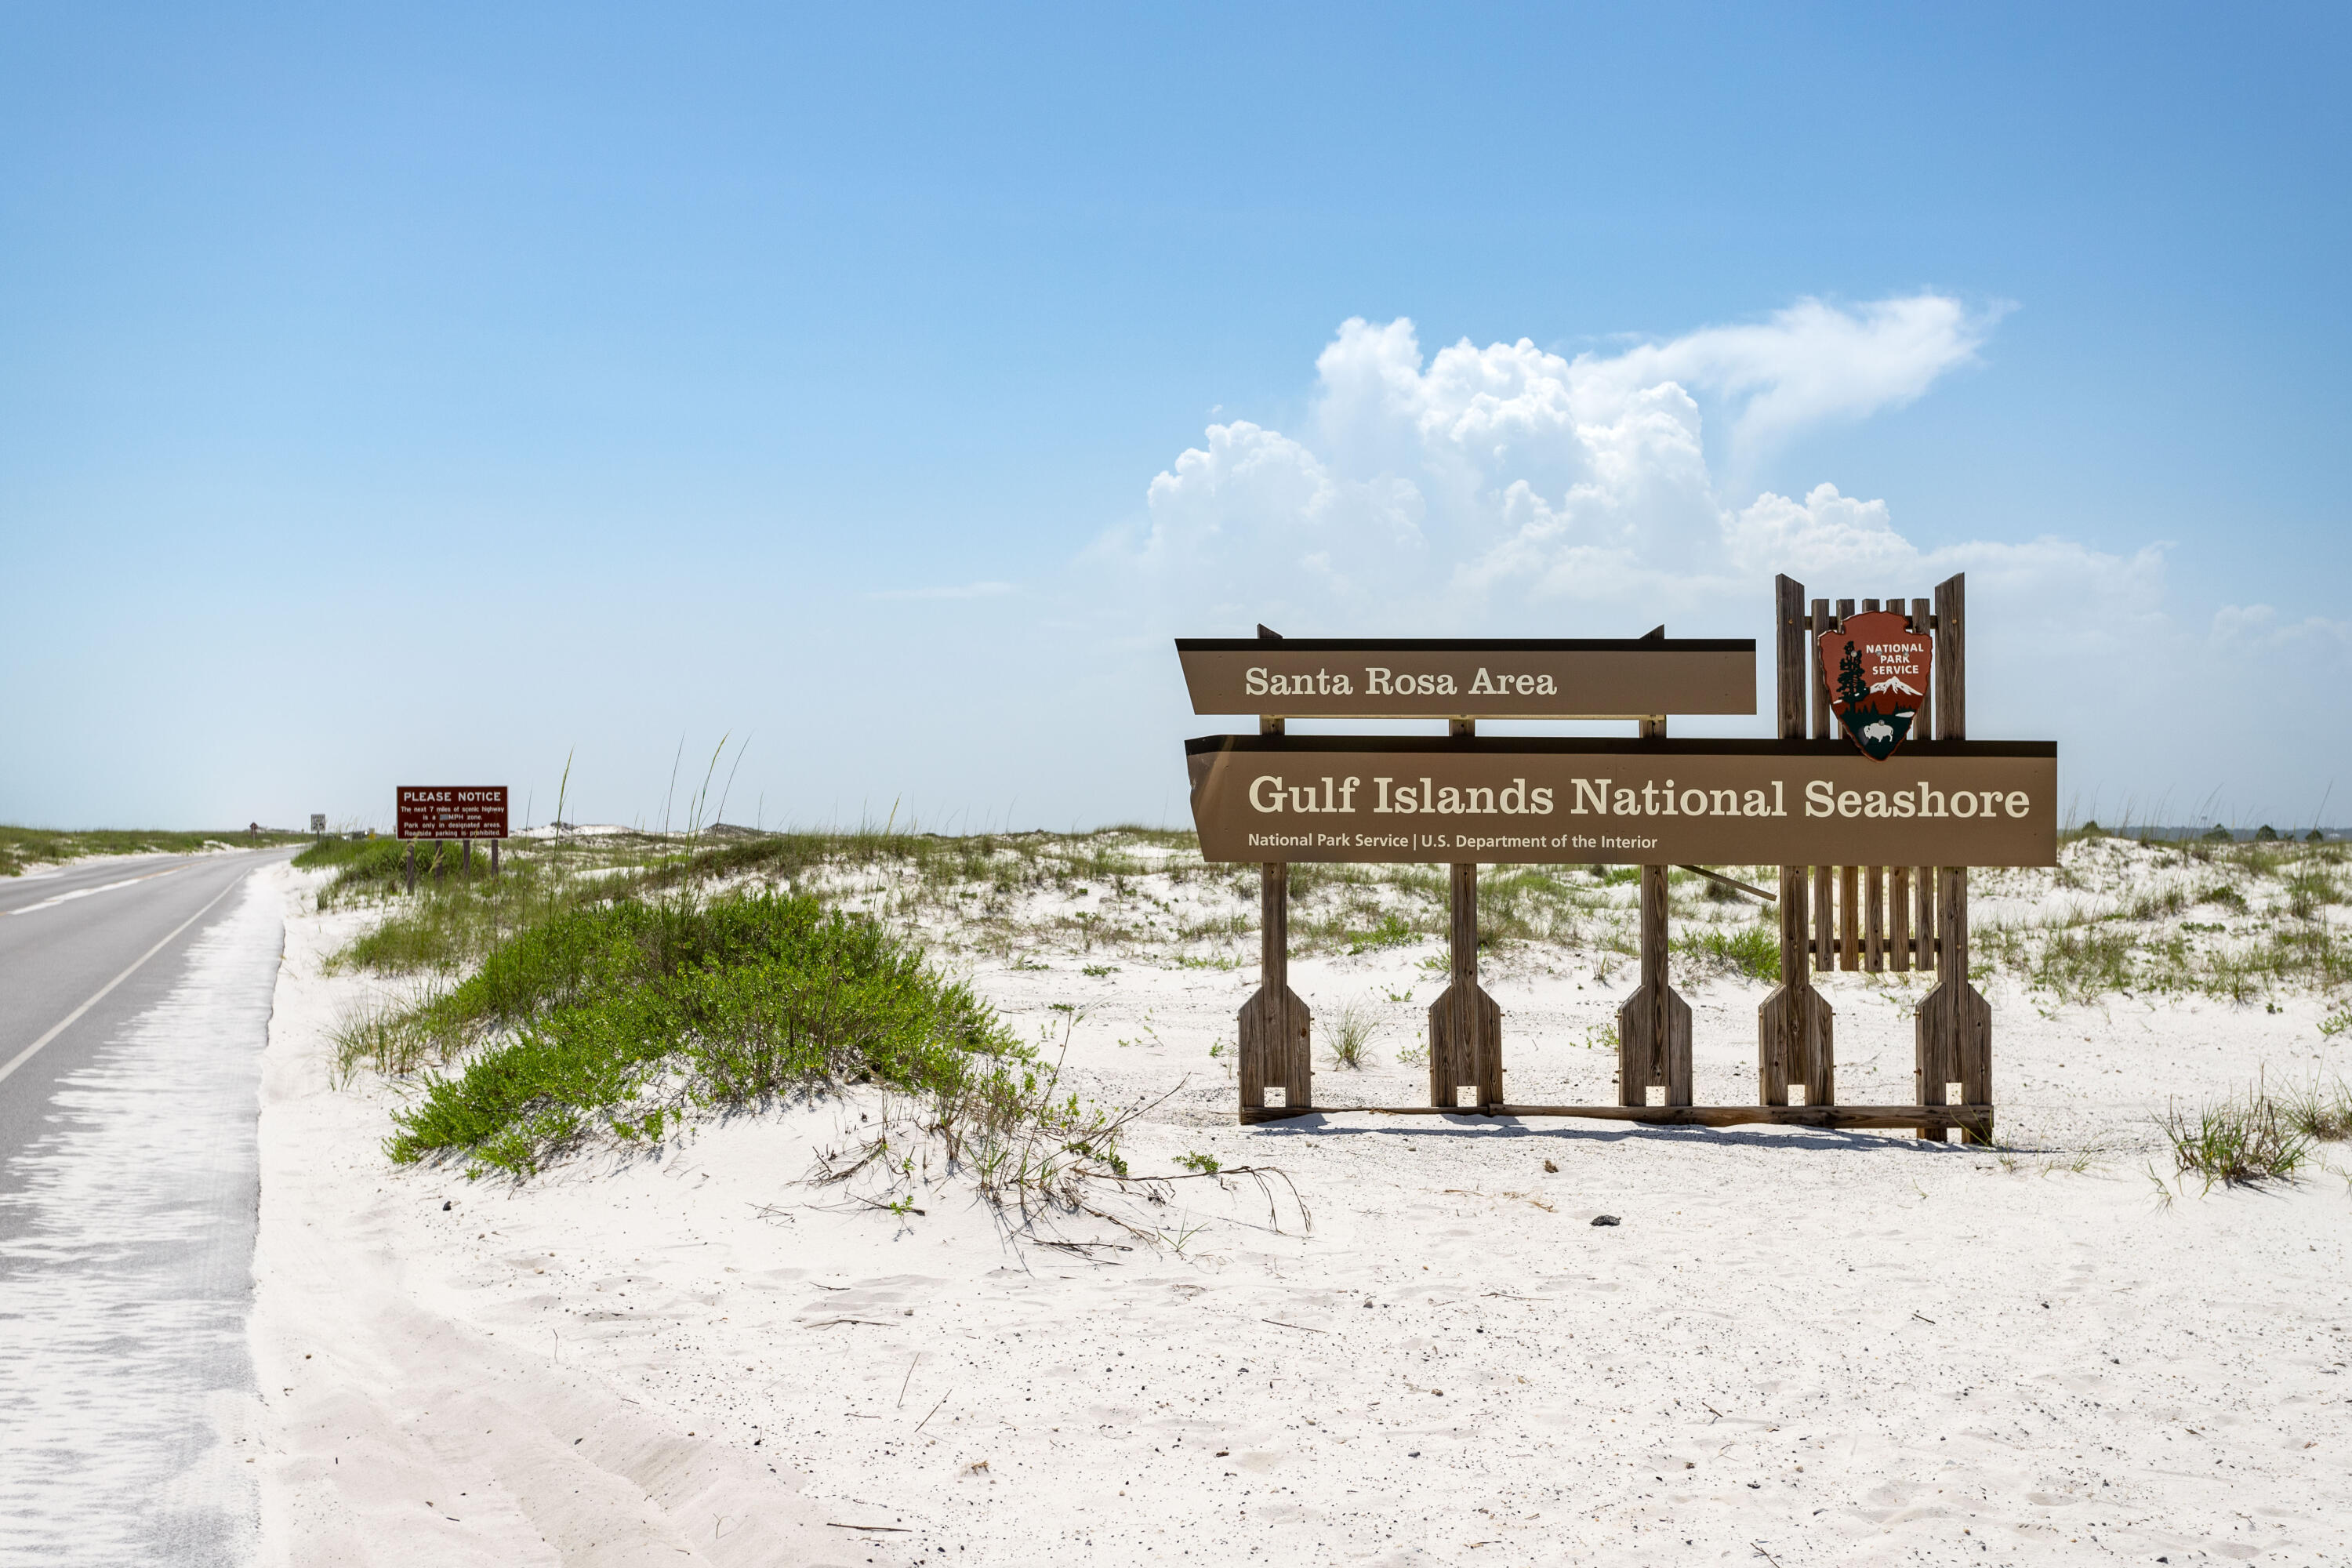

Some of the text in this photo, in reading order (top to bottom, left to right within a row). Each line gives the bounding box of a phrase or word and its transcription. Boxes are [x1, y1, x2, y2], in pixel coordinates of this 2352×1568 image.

[1866, 644, 1924, 654] NATIONAL
[1880, 654, 1911, 664] PARK
[1872, 665, 1919, 675] SERVICE
[1245, 667, 1558, 695] Santa Rosa Area
[404, 792, 501, 802] PLEASE NOTICE
[1248, 775, 2031, 818] Gulf Islands National Seashore
[1248, 833, 1312, 847] National
[1317, 833, 1351, 847] Park
[1355, 833, 1410, 848] Service
[1421, 835, 1451, 848] U.S.
[1455, 835, 1547, 851] Department
[1551, 834, 1569, 848] of
[1571, 834, 1598, 848] the
[1601, 835, 1658, 849] Interior
